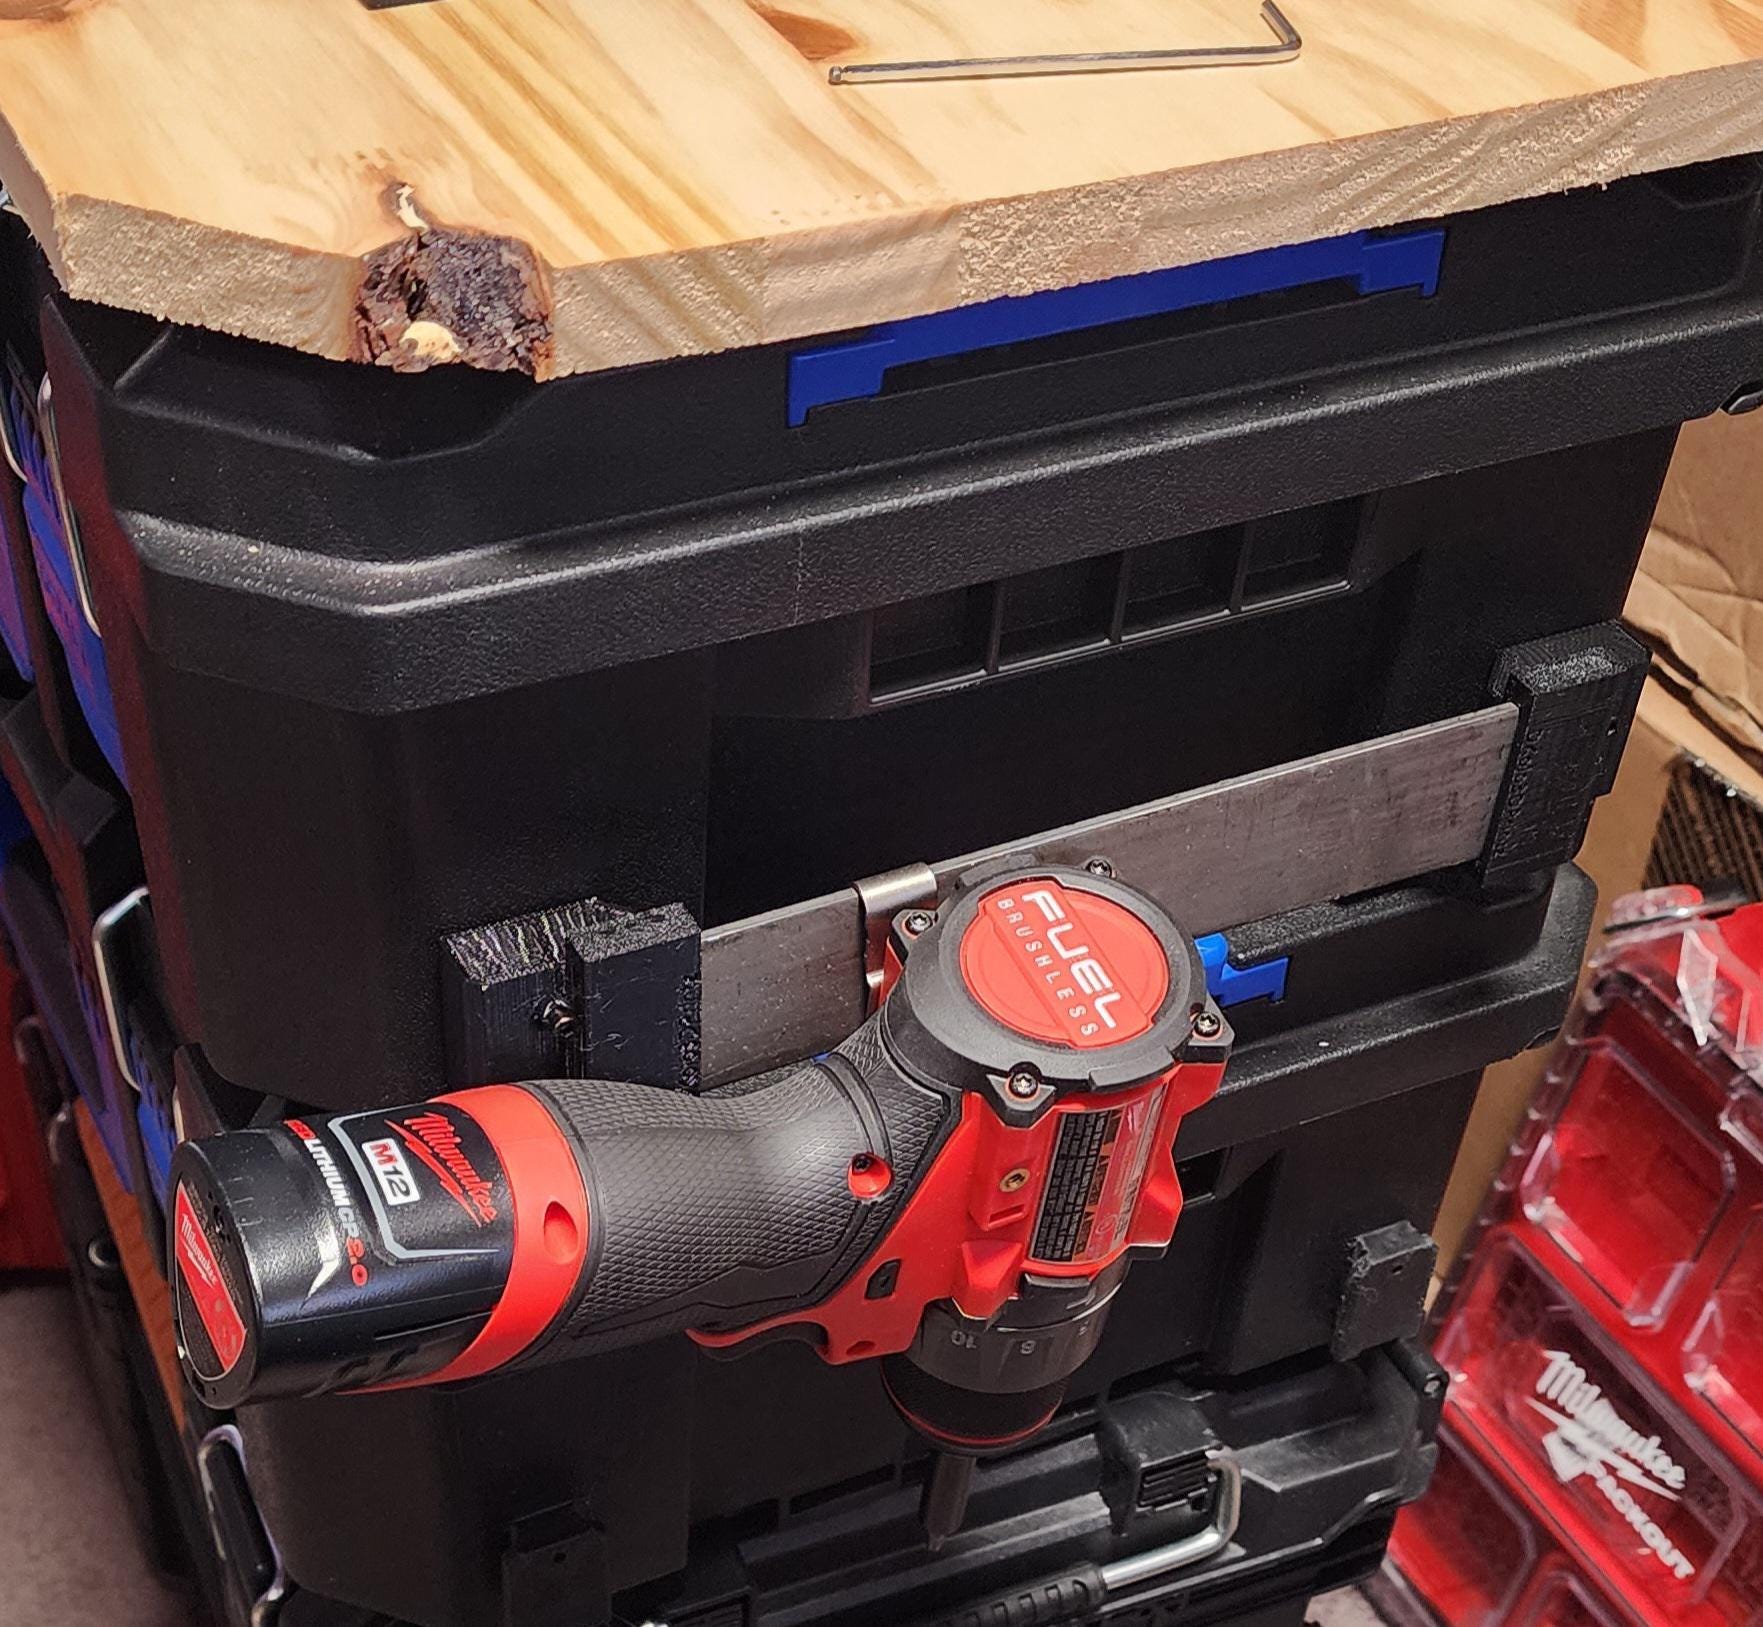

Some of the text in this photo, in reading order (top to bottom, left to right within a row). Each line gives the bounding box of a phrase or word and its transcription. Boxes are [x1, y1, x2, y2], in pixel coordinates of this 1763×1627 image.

[997, 897, 1099, 1036] BRUSHLESS
[1020, 889, 1121, 1029] FUEL
[369, 1142, 411, 1198] M12
[403, 1111, 498, 1224] Milwaukee
[179, 1213, 219, 1286] Milwaukee
[1535, 1349, 1686, 1490] Milwaukee
